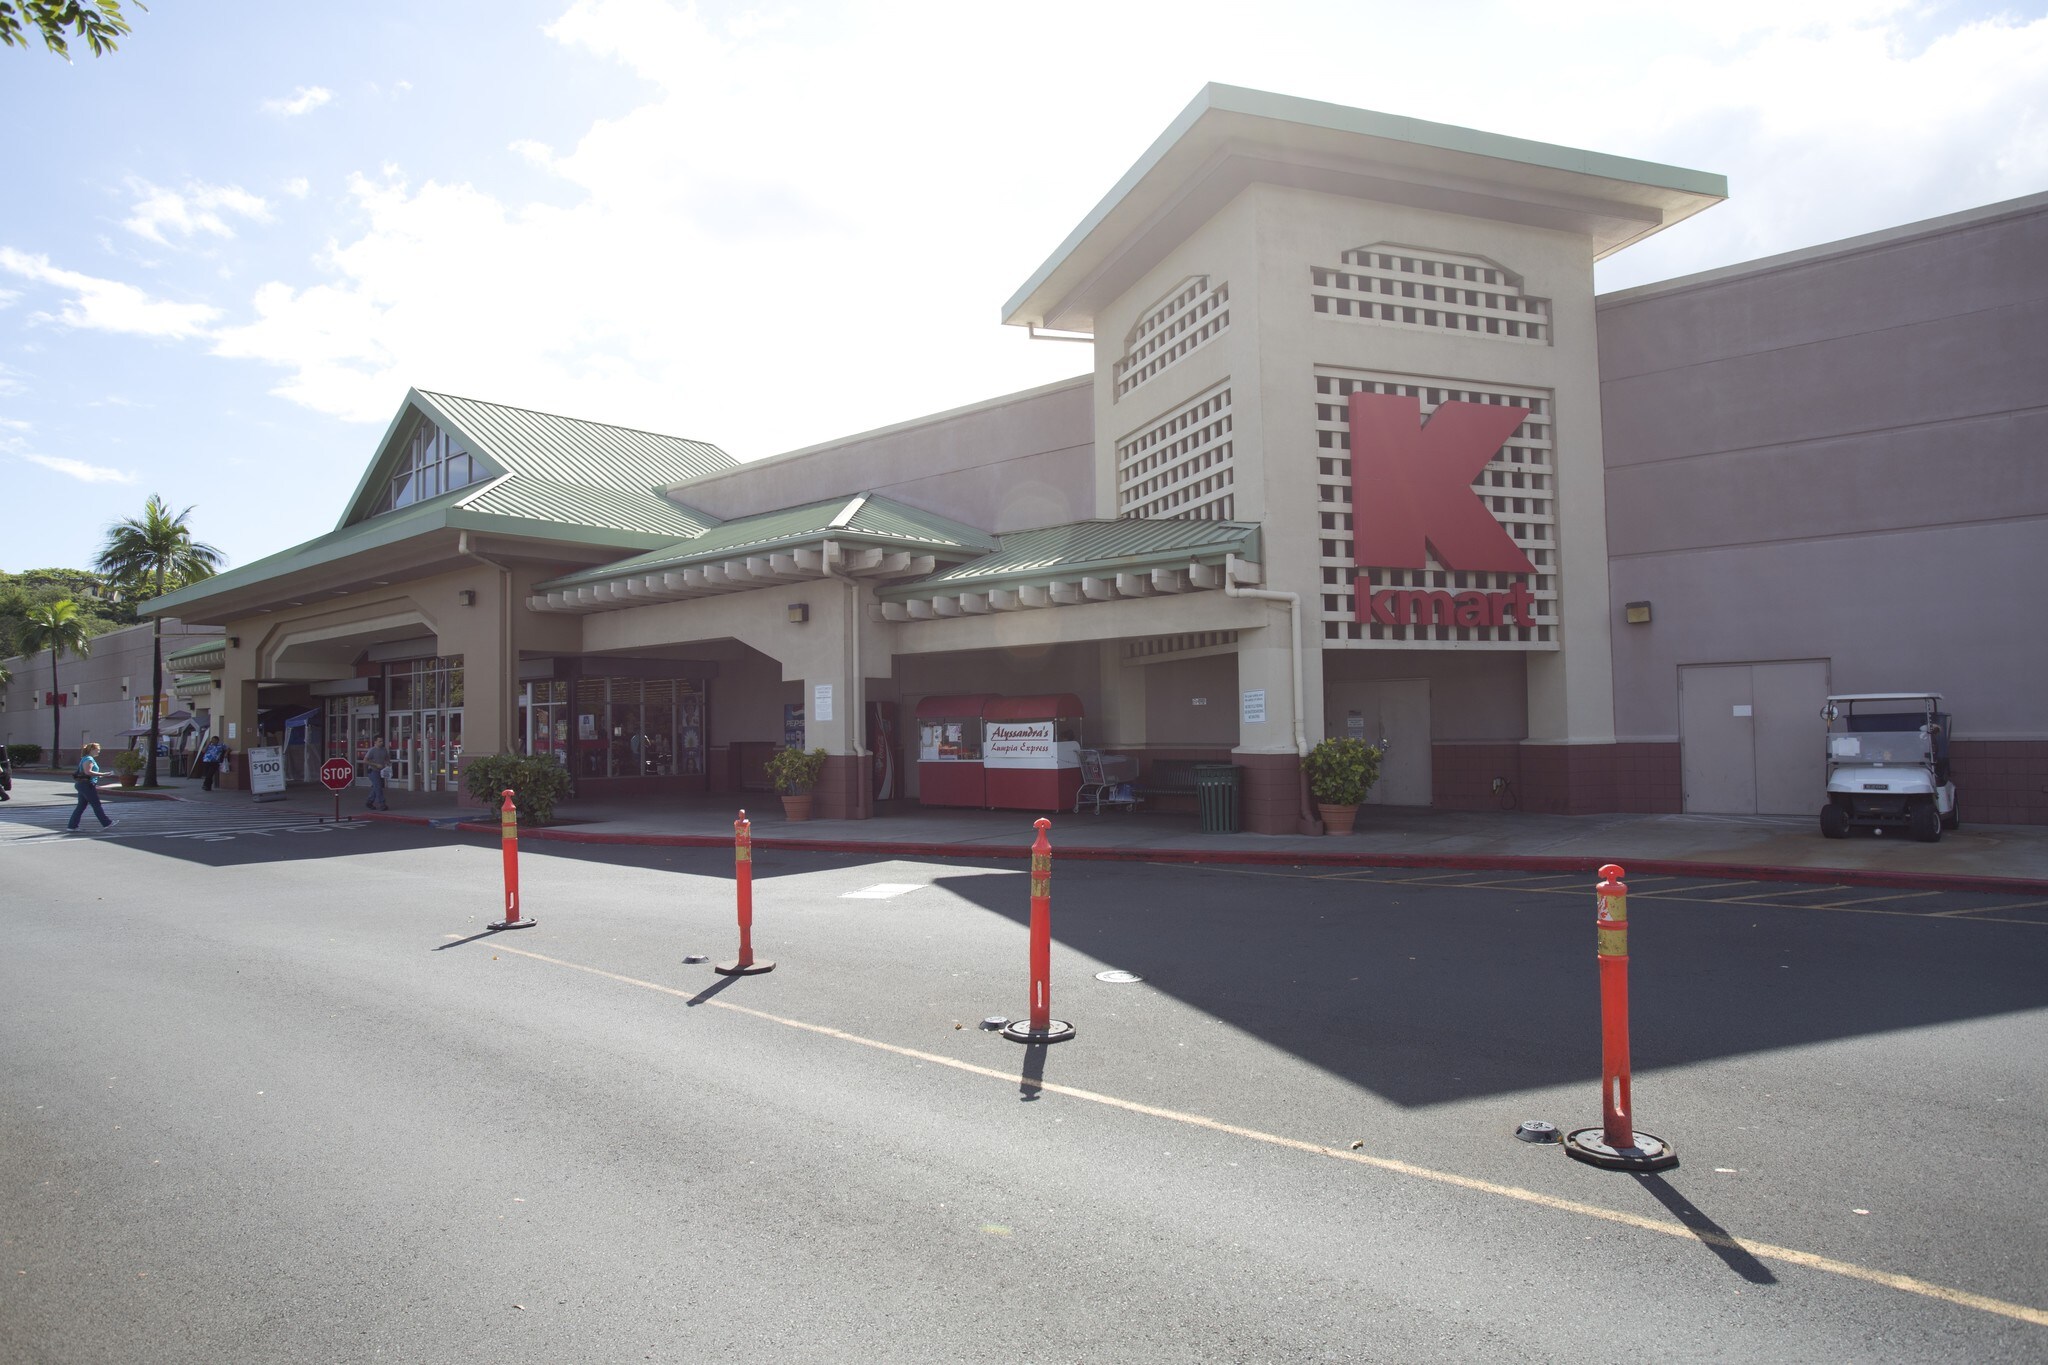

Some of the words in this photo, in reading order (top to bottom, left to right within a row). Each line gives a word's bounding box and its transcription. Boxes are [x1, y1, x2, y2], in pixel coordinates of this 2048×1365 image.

[1348, 391, 1539, 574] K
[1353, 575, 1537, 628] kmart
[786, 719, 805, 727] PEPS
[991, 725, 1049, 740] Alyssandra's
[991, 743, 1018, 754] Lumpia
[1020, 742, 1049, 754] Express
[253, 762, 280, 773] $100
[323, 767, 352, 780] STOP
